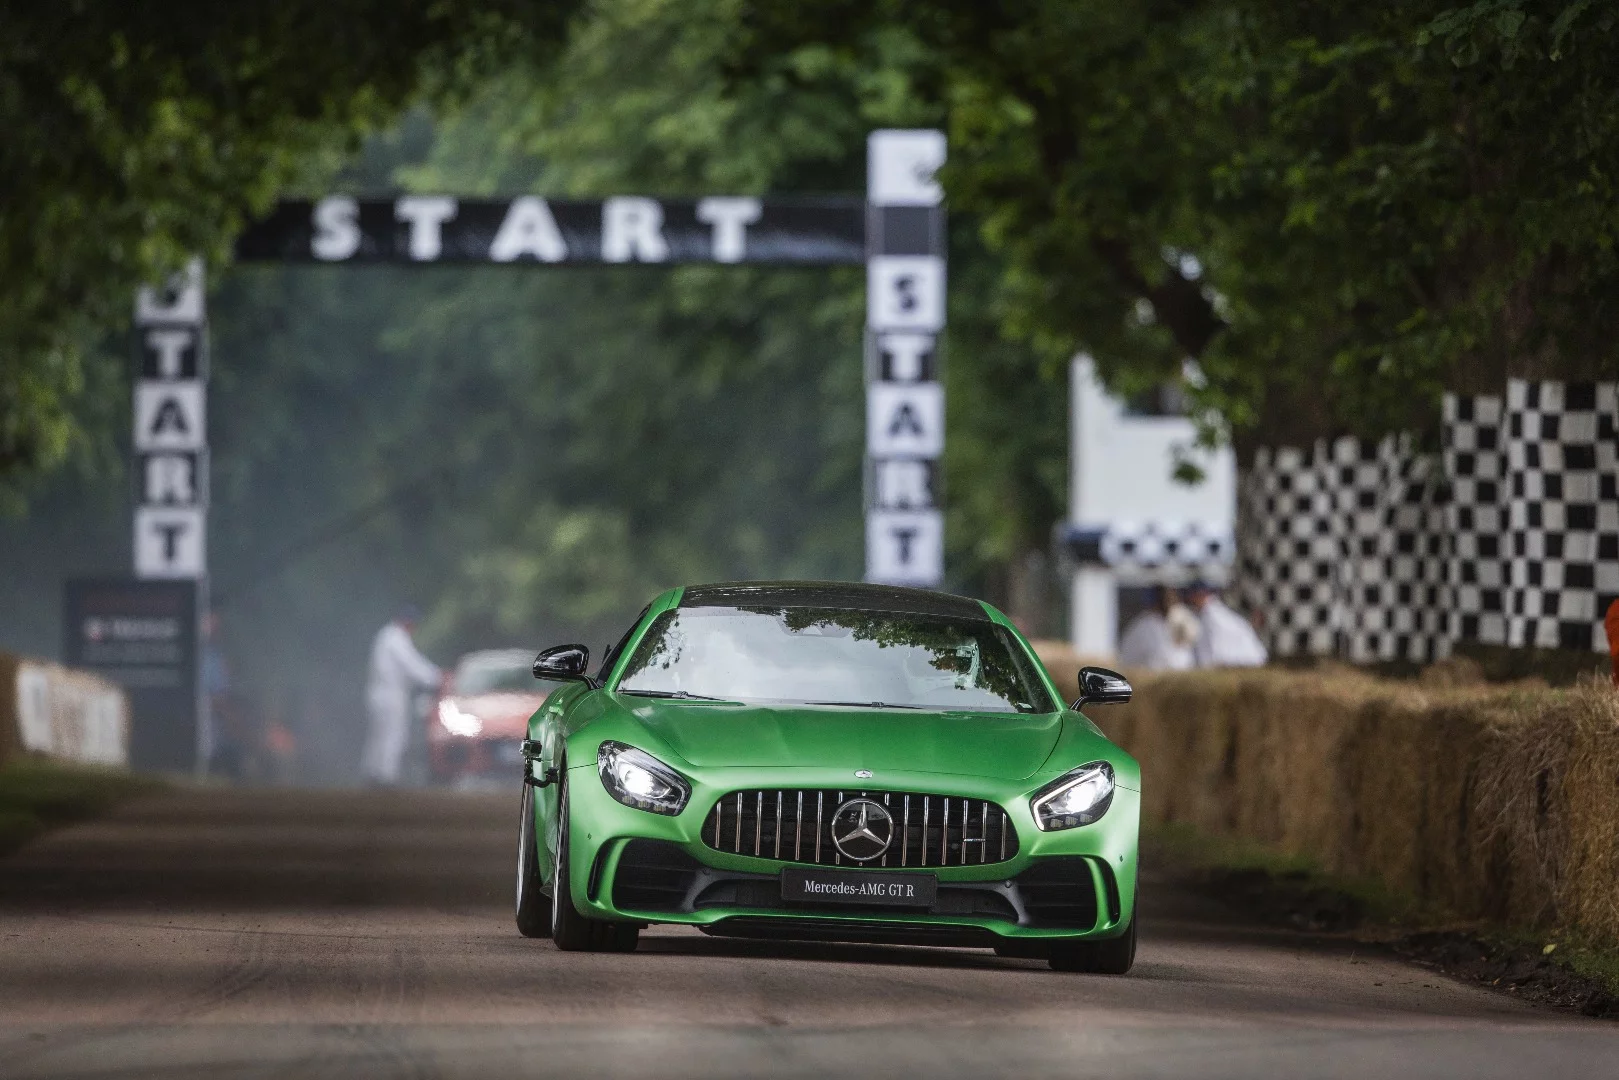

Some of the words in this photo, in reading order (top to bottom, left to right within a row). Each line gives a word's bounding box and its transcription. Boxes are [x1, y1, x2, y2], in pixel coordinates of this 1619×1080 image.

[310, 195, 763, 263] START
[878, 274, 935, 564] START
[804, 879, 886, 896] Mercedes-AMG
[888, 883, 904, 897] GT
[906, 884, 915, 897] R
